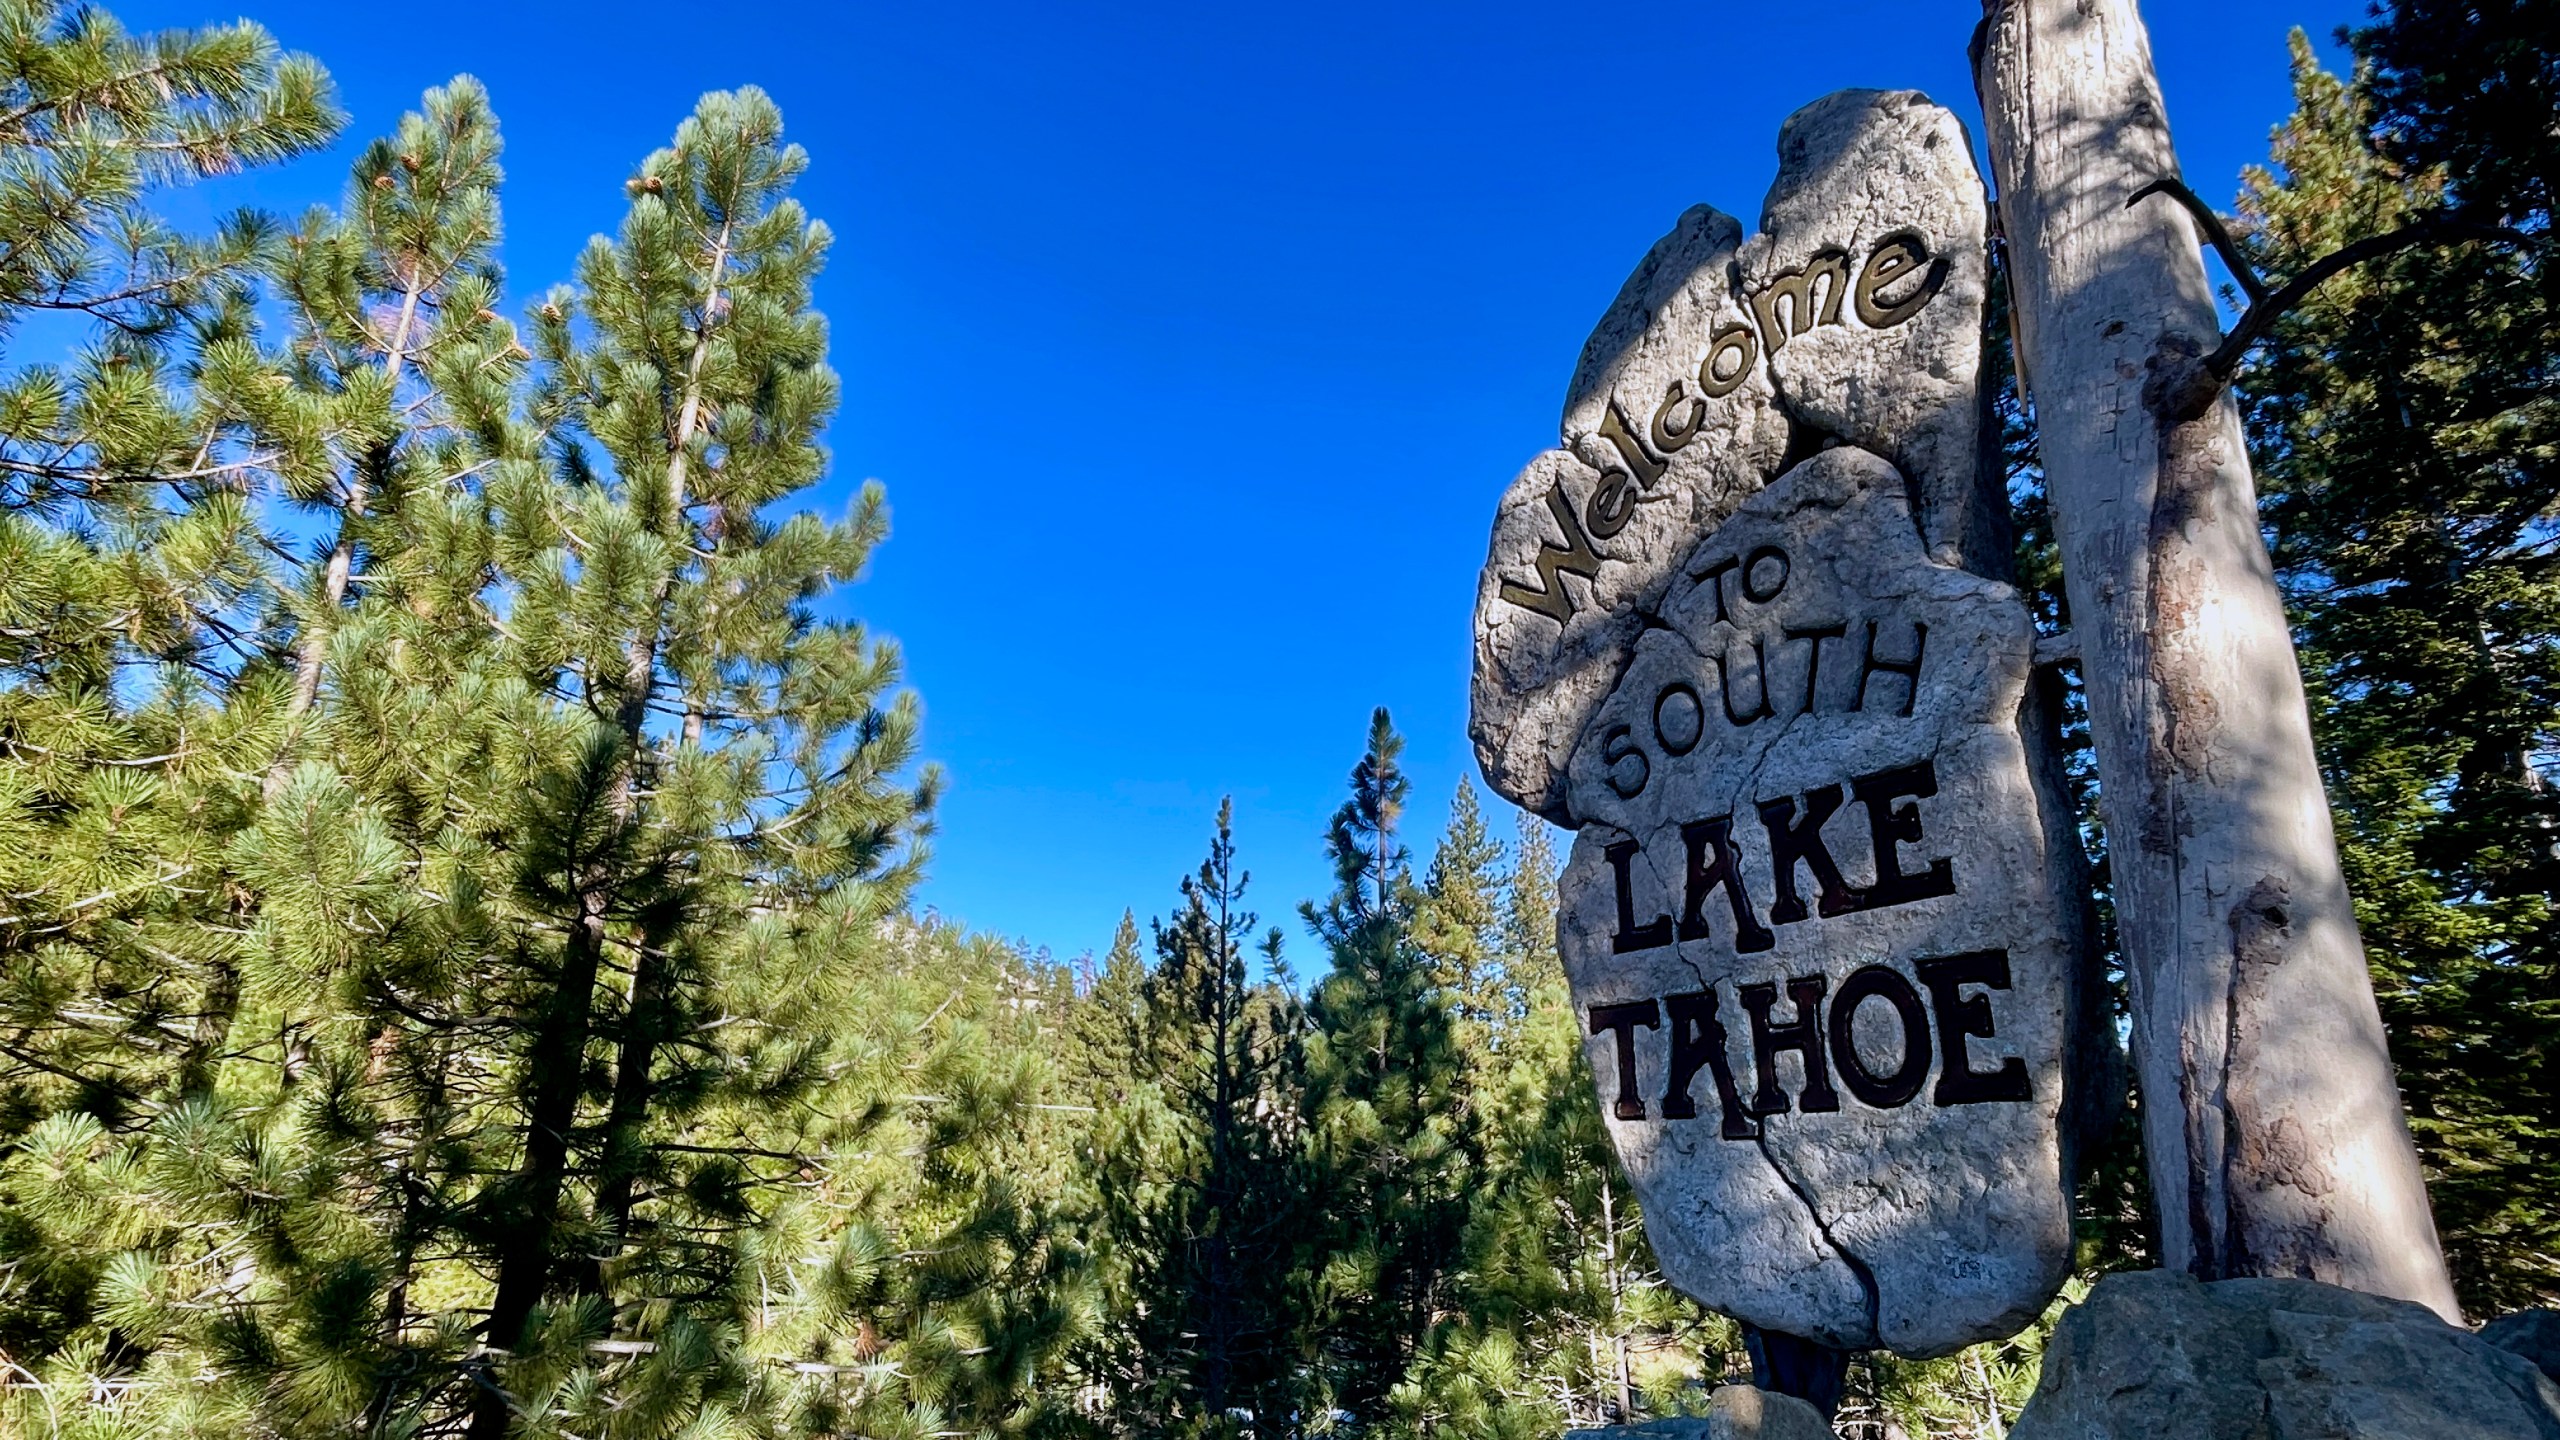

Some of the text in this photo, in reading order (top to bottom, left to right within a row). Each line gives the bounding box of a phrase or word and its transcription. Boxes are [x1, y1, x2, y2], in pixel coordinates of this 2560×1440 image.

[1500, 232, 1950, 626] Welcome
[1690, 544, 1791, 624] TO
[1602, 620, 1928, 800] SOUTH
[1603, 759, 1957, 955] LAKE
[1588, 947, 2033, 1141] TAHOE
